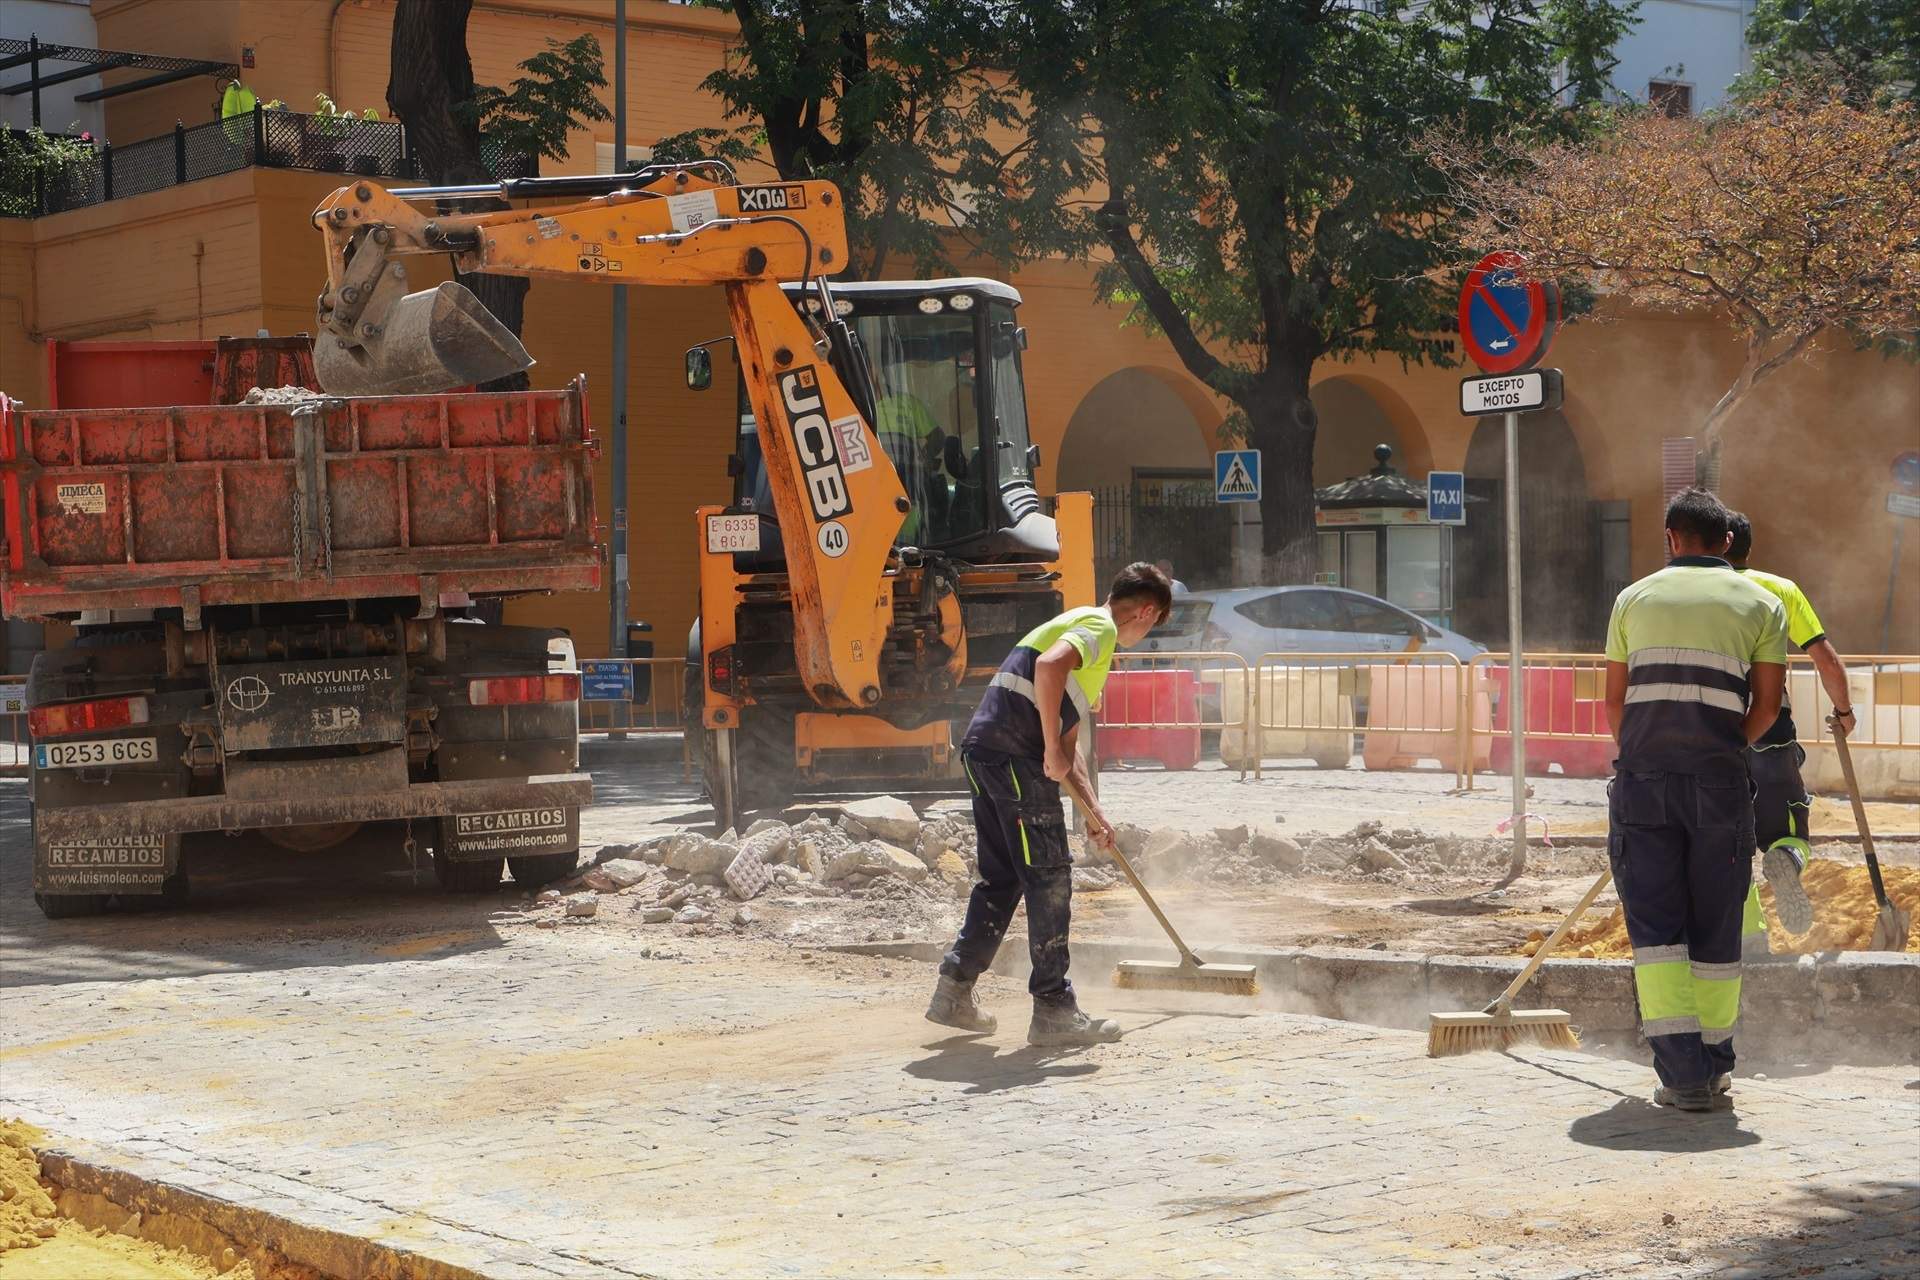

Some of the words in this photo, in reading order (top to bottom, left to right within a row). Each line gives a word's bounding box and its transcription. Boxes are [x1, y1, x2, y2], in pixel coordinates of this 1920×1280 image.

[1478, 378, 1525, 394] EXCEPTO
[1483, 393, 1520, 407] MOTOS
[782, 373, 847, 518] JCB
[59, 485, 104, 497] JIMECA
[1432, 489, 1461, 505] TAXI
[724, 518, 756, 532] 6335
[825, 529, 844, 550] 40
[279, 669, 371, 686] TRANSYUNTA
[323, 686, 337, 694] 615
[337, 685, 351, 693] 416
[50, 743, 105, 765] 0253
[112, 741, 153, 761] GCS
[460, 809, 563, 832] RECAMBIOS
[458, 833, 568, 852] www.luismoleon.com
[52, 849, 161, 863] RECAMBIOS
[48, 871, 164, 885] www.luismoleon.com
